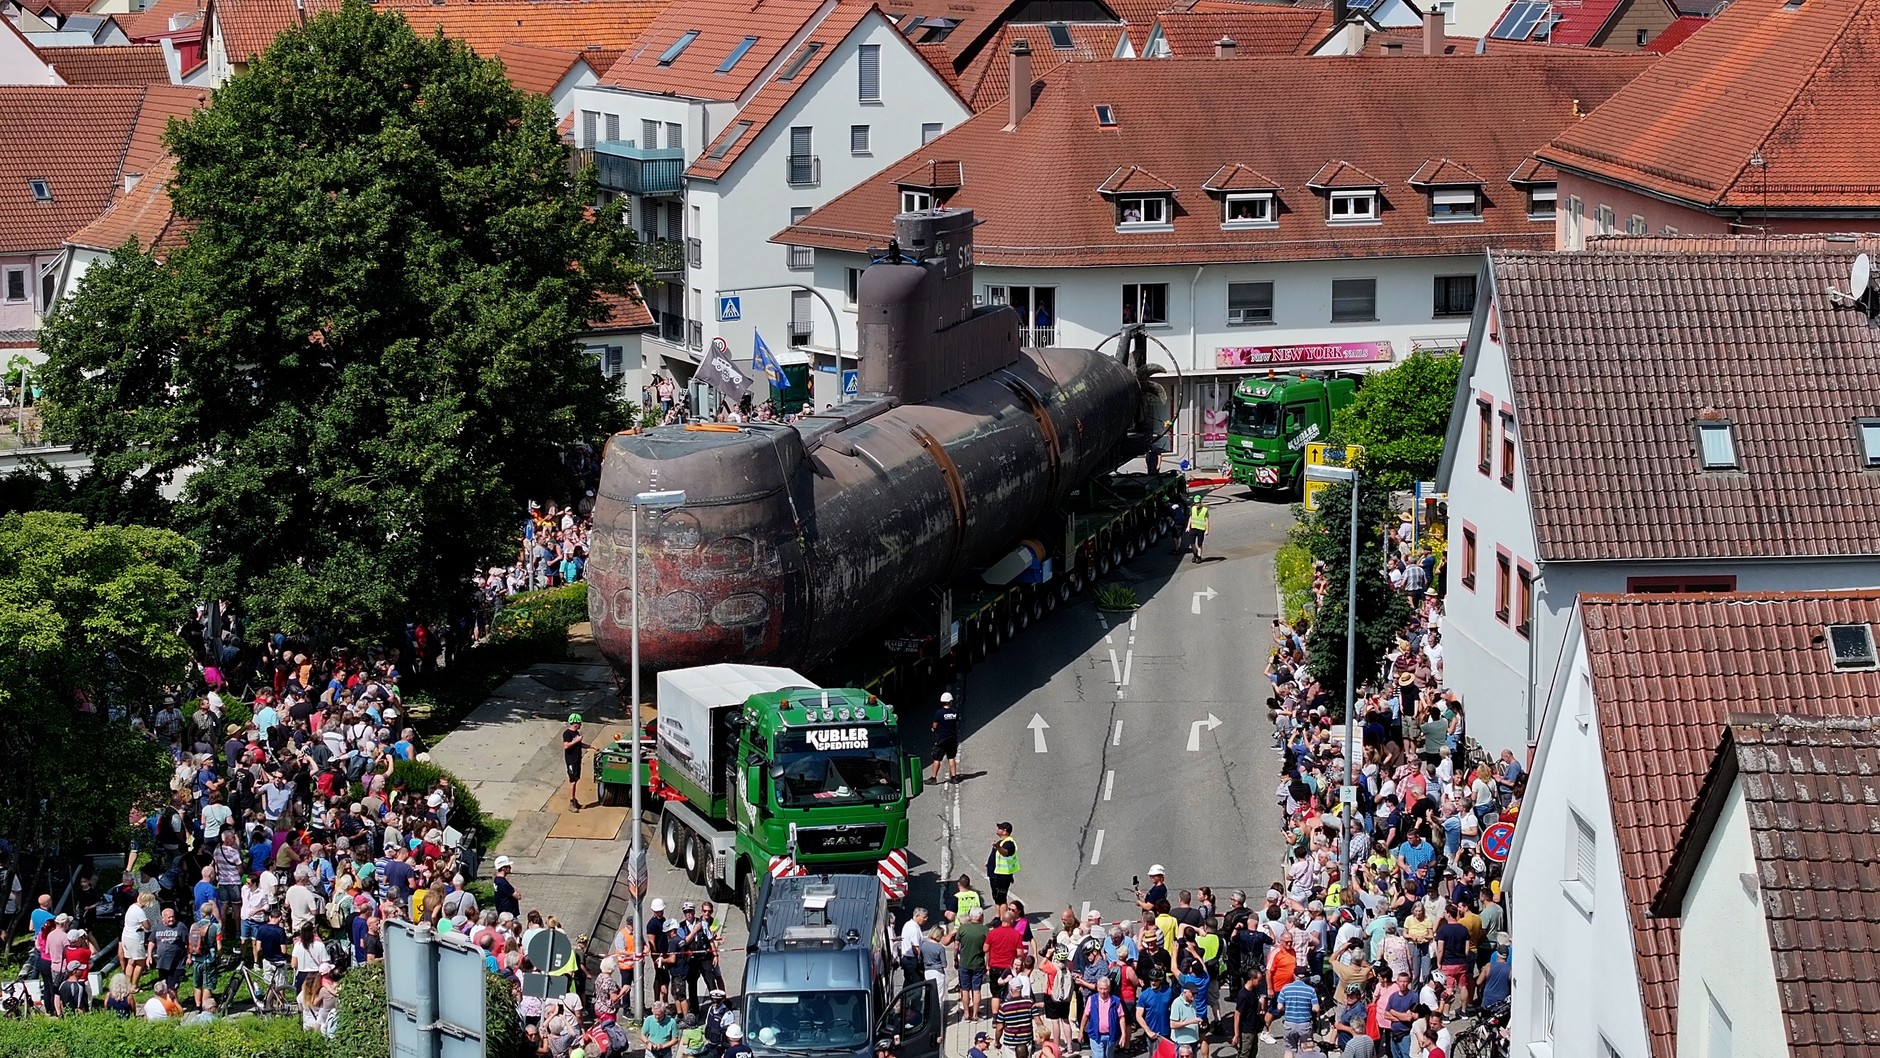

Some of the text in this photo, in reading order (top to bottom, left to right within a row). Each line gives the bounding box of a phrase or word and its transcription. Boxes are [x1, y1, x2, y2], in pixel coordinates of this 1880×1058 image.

[1250, 352, 1271, 362] NEW
[1271, 347, 1304, 361] NEW
[1305, 346, 1343, 360] YORK
[806, 727, 869, 750] KÜBLER
[818, 740, 869, 750] SPEDITION
